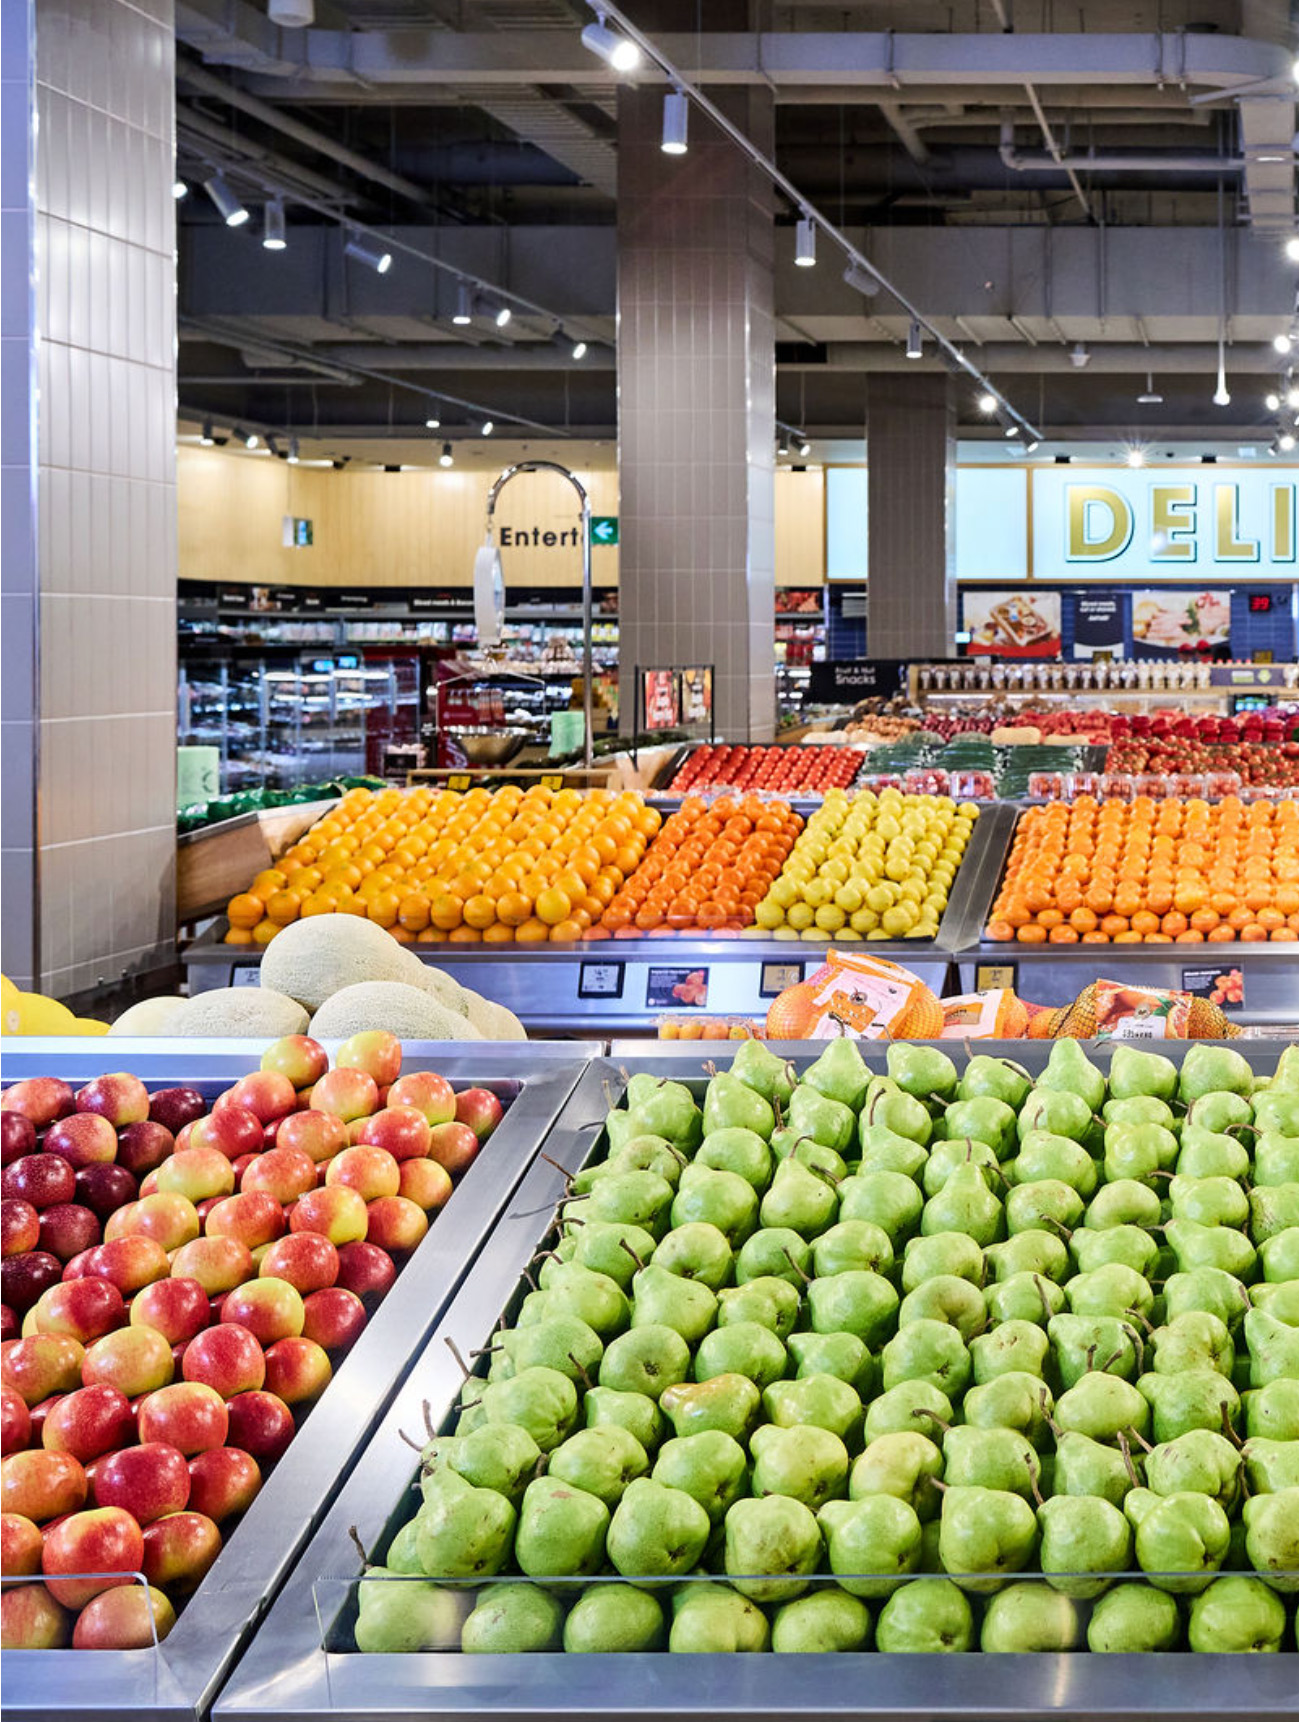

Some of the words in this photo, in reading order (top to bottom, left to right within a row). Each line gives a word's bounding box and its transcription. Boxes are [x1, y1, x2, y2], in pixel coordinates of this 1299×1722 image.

[1065, 483, 1297, 563] DELI
[500, 527, 584, 547] Entert
[835, 674, 876, 685] Snacks
